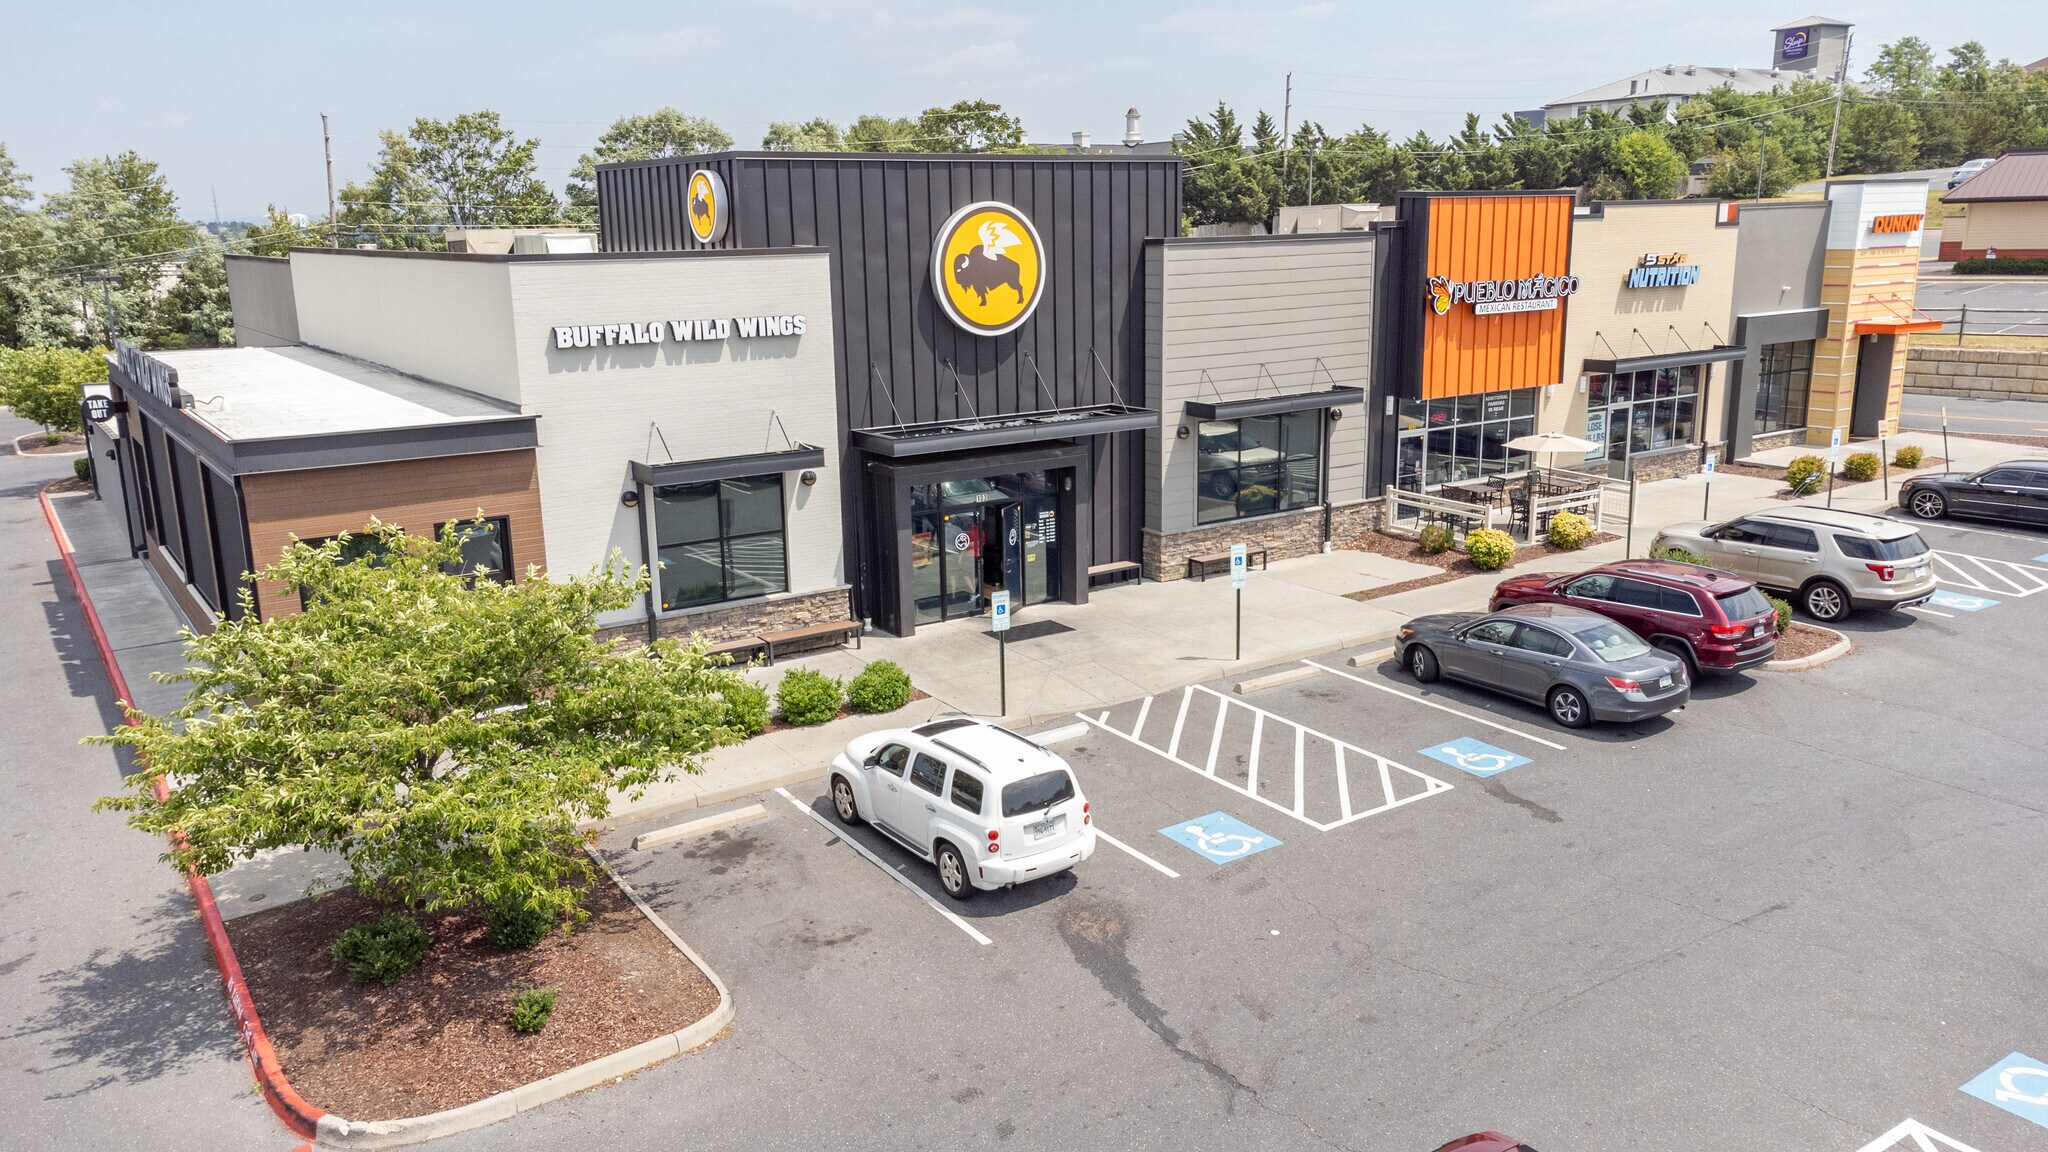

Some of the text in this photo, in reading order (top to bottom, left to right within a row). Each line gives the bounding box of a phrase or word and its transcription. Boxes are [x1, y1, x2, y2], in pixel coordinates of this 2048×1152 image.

[1645, 253, 1657, 266] 5
[1628, 265, 1700, 288] NUTRITION
[1453, 281, 1516, 304] PUEBLO
[1479, 299, 1554, 313] MEXICAN RESTAURANT
[553, 314, 807, 349] BUFFALO WILD WINGS
[86, 399, 109, 409] TAKE
[91, 409, 108, 419] OUT
[1587, 421, 1603, 432] LOSE
[1593, 432, 1605, 442] LBS
